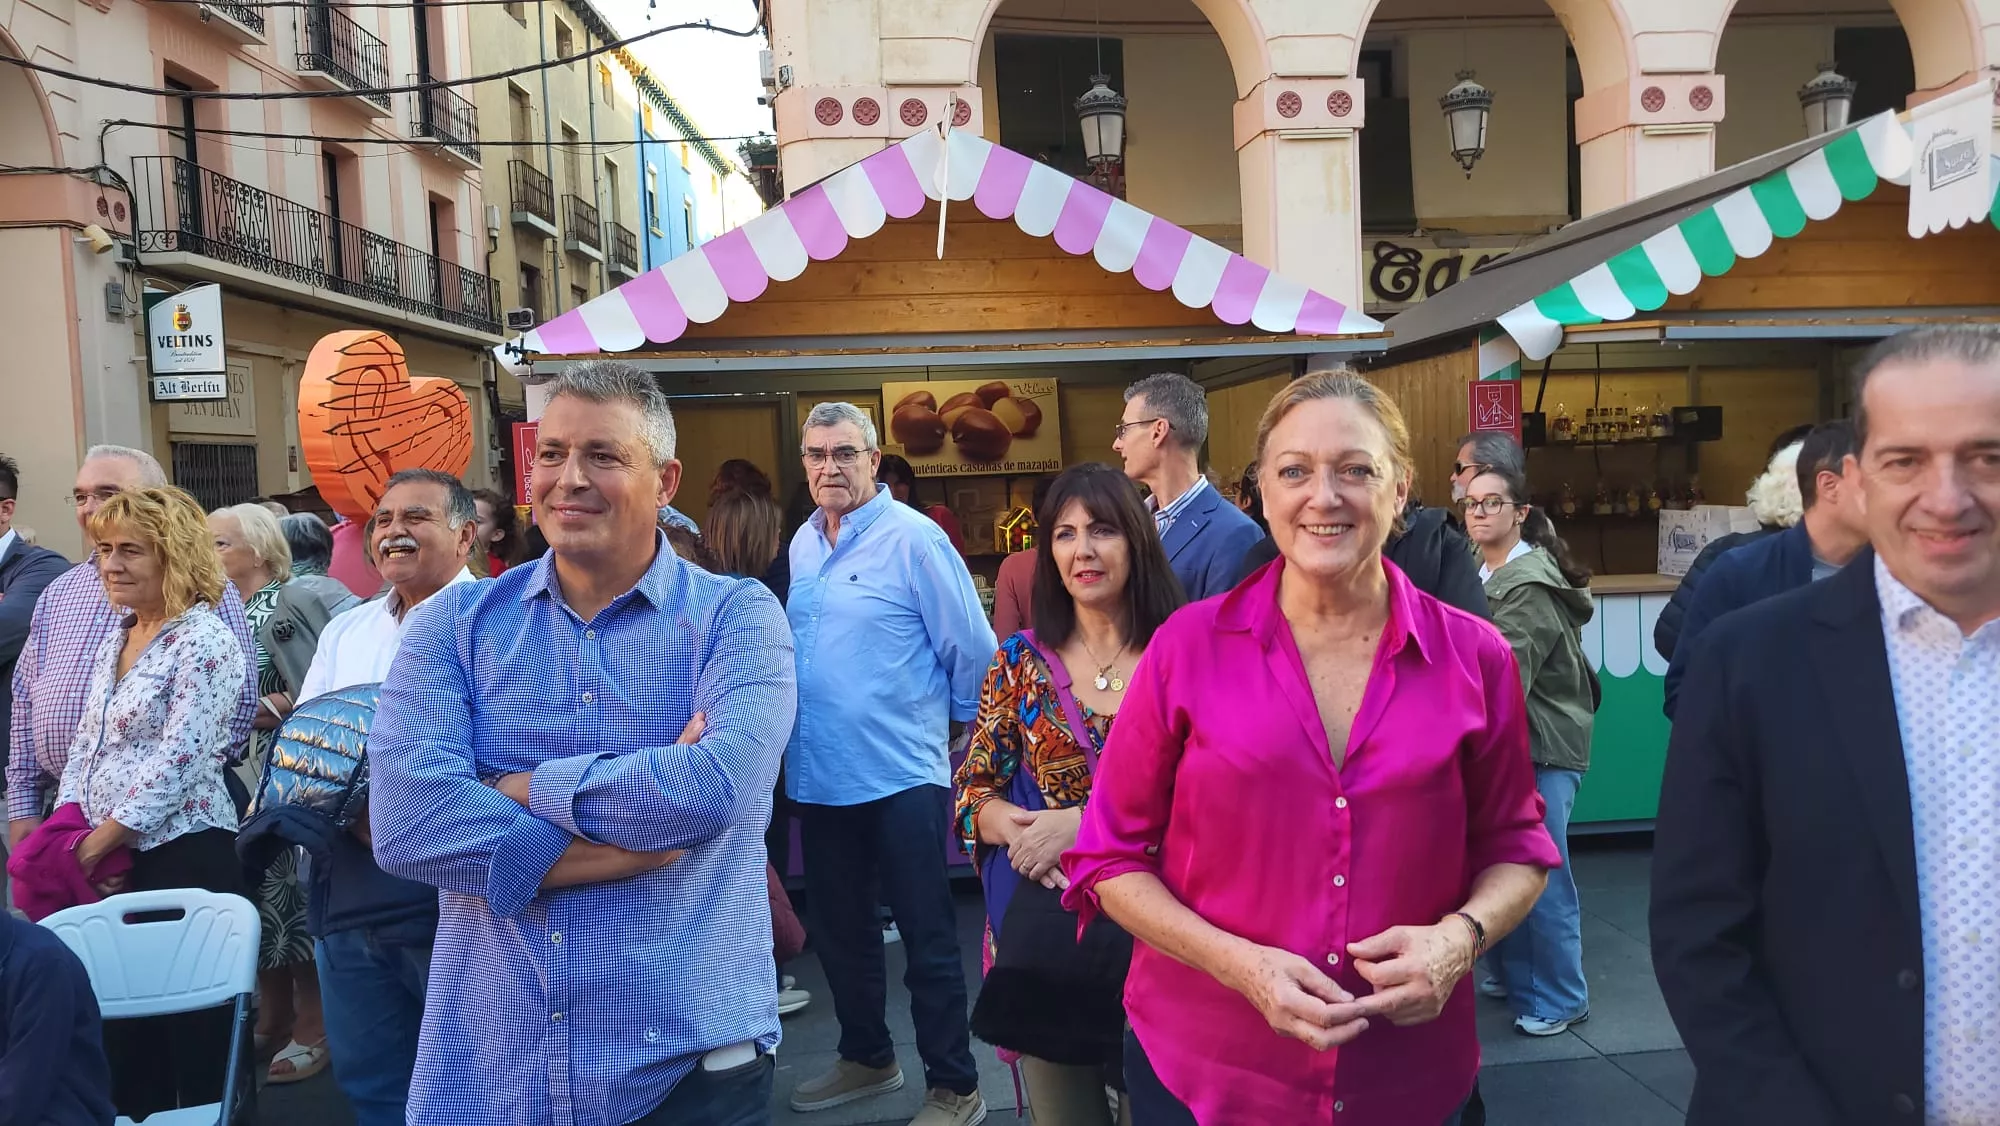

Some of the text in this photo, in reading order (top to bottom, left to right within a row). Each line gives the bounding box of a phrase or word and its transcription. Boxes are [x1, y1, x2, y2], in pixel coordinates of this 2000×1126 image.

[157, 334, 214, 348] VELTINS
[159, 381, 220, 394] Alt Berlin
[1004, 460, 1015, 471] de
[1017, 458, 1059, 472] mazapán
